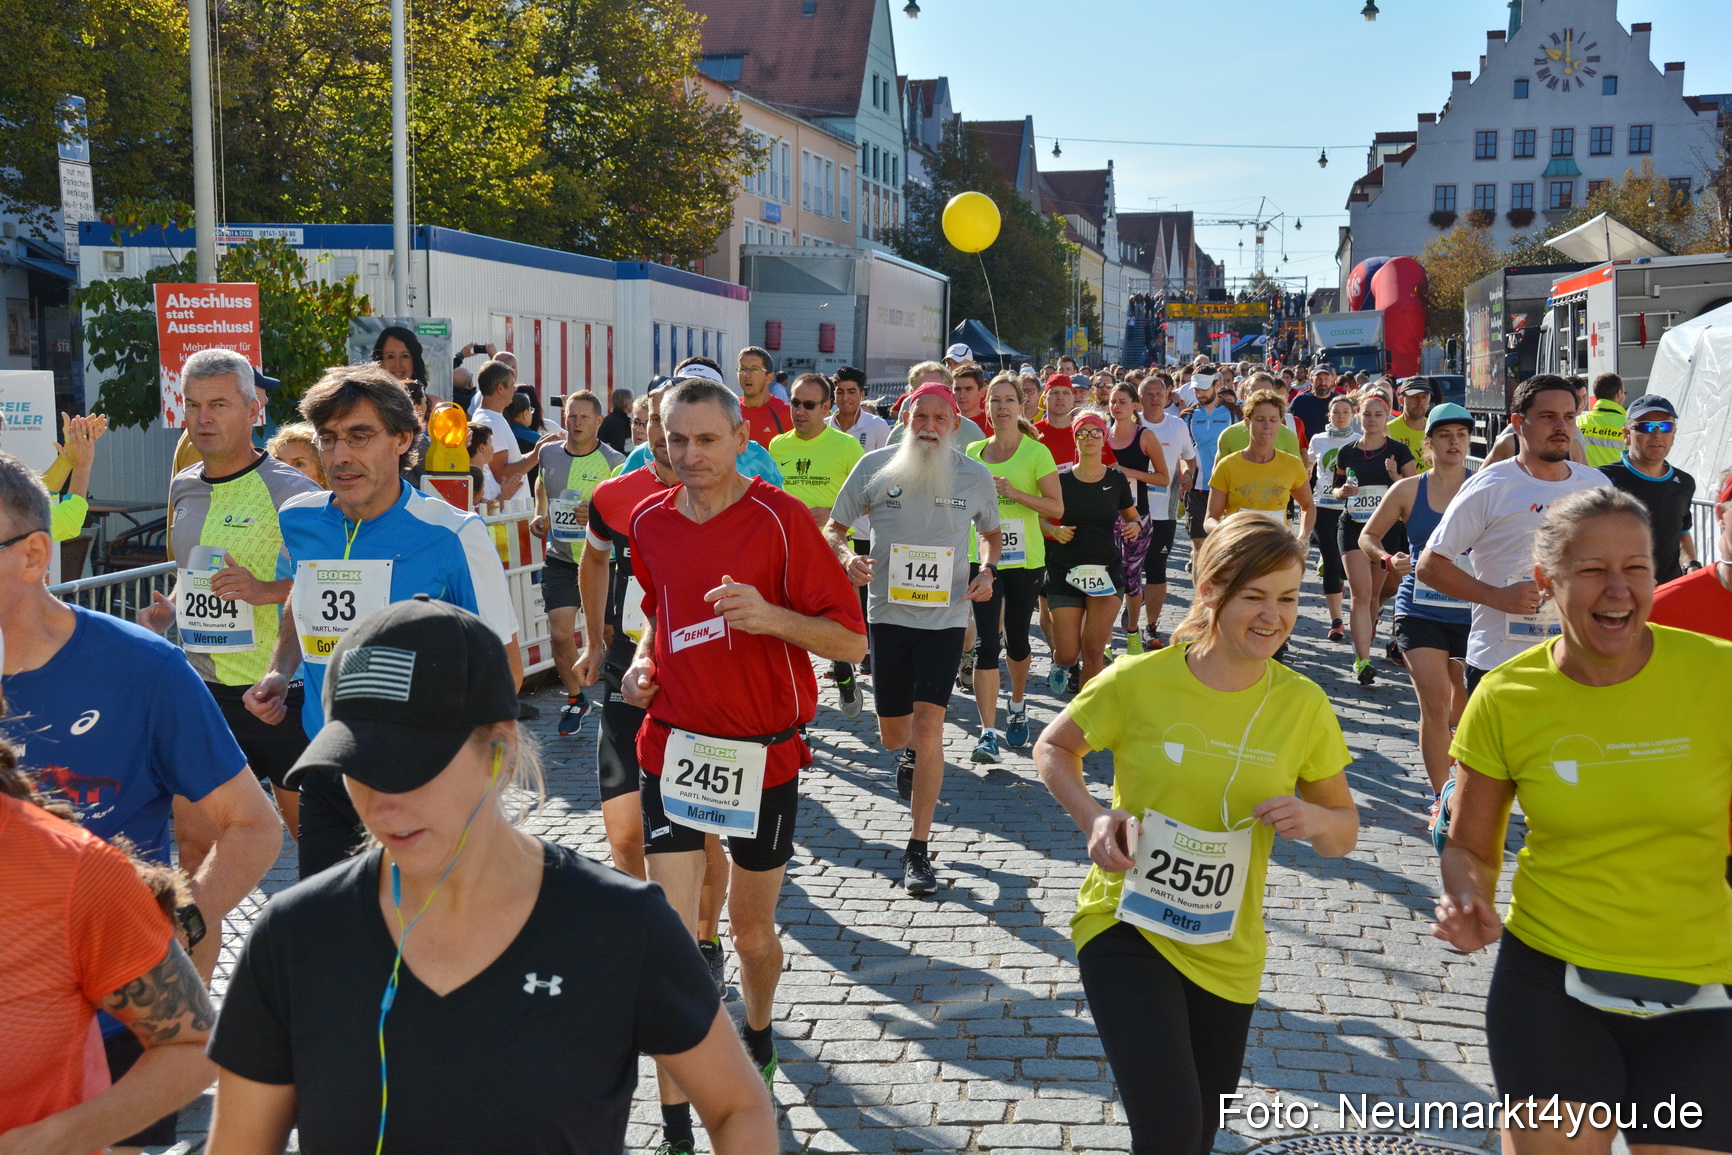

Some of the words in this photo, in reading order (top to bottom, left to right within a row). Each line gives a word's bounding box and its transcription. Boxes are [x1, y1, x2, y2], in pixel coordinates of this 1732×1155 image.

[66, 167, 76, 177] nur
[76, 168, 86, 178] mit
[63, 175, 91, 189] Parkschein
[66, 188, 89, 199] werktags
[165, 292, 253, 309] Abschluss
[166, 309, 195, 319] statt
[1199, 305, 1234, 315] START
[167, 319, 254, 334] Ausschluss!
[182, 342, 207, 352] Mehr
[209, 342, 237, 352] Lehrer
[239, 341, 251, 351] für
[6, 414, 43, 425] HLER
[1354, 496, 1382, 508] 2038
[909, 550, 937, 559] BOCK
[317, 570, 362, 581] BOCK
[905, 562, 939, 582] 144
[911, 591, 929, 601] Axel
[185, 592, 238, 619] 2894
[321, 589, 356, 621] 33
[188, 620, 202, 628] PARTL
[193, 632, 228, 644] Werner
[684, 626, 710, 642] DEHN
[317, 639, 338, 653] Got
[693, 742, 738, 760] BOCK
[1210, 739, 1235, 749] Kliniken
[1605, 742, 1637, 750] Kliniken
[1629, 747, 1666, 756] Neumarkt
[675, 758, 744, 796] 2451
[679, 790, 701, 800] PARTL
[701, 795, 731, 806] Neumarkt
[687, 805, 726, 824] Martin
[1173, 832, 1228, 854] BOCK
[1145, 848, 1235, 898] 2550
[1150, 886, 1176, 902] PARTL
[1177, 897, 1213, 910] Neumarkt
[1162, 907, 1202, 932] Petra
